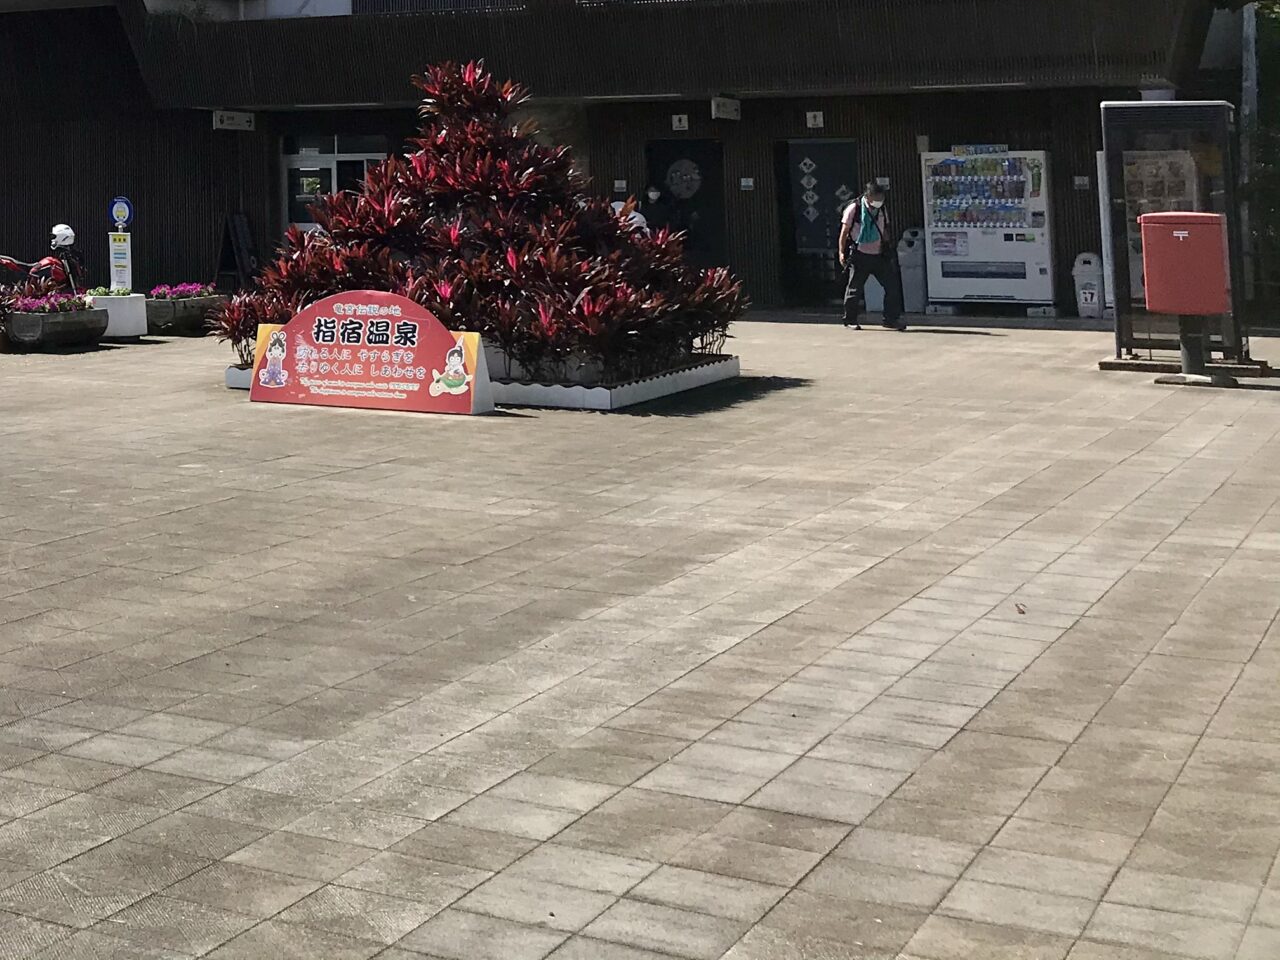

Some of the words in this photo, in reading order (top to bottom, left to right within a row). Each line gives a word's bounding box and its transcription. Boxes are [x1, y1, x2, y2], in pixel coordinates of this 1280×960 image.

[313, 317, 419, 346] 指宿温泉
[357, 349, 415, 363] やすらぎを
[369, 364, 427, 379] しあわせを
